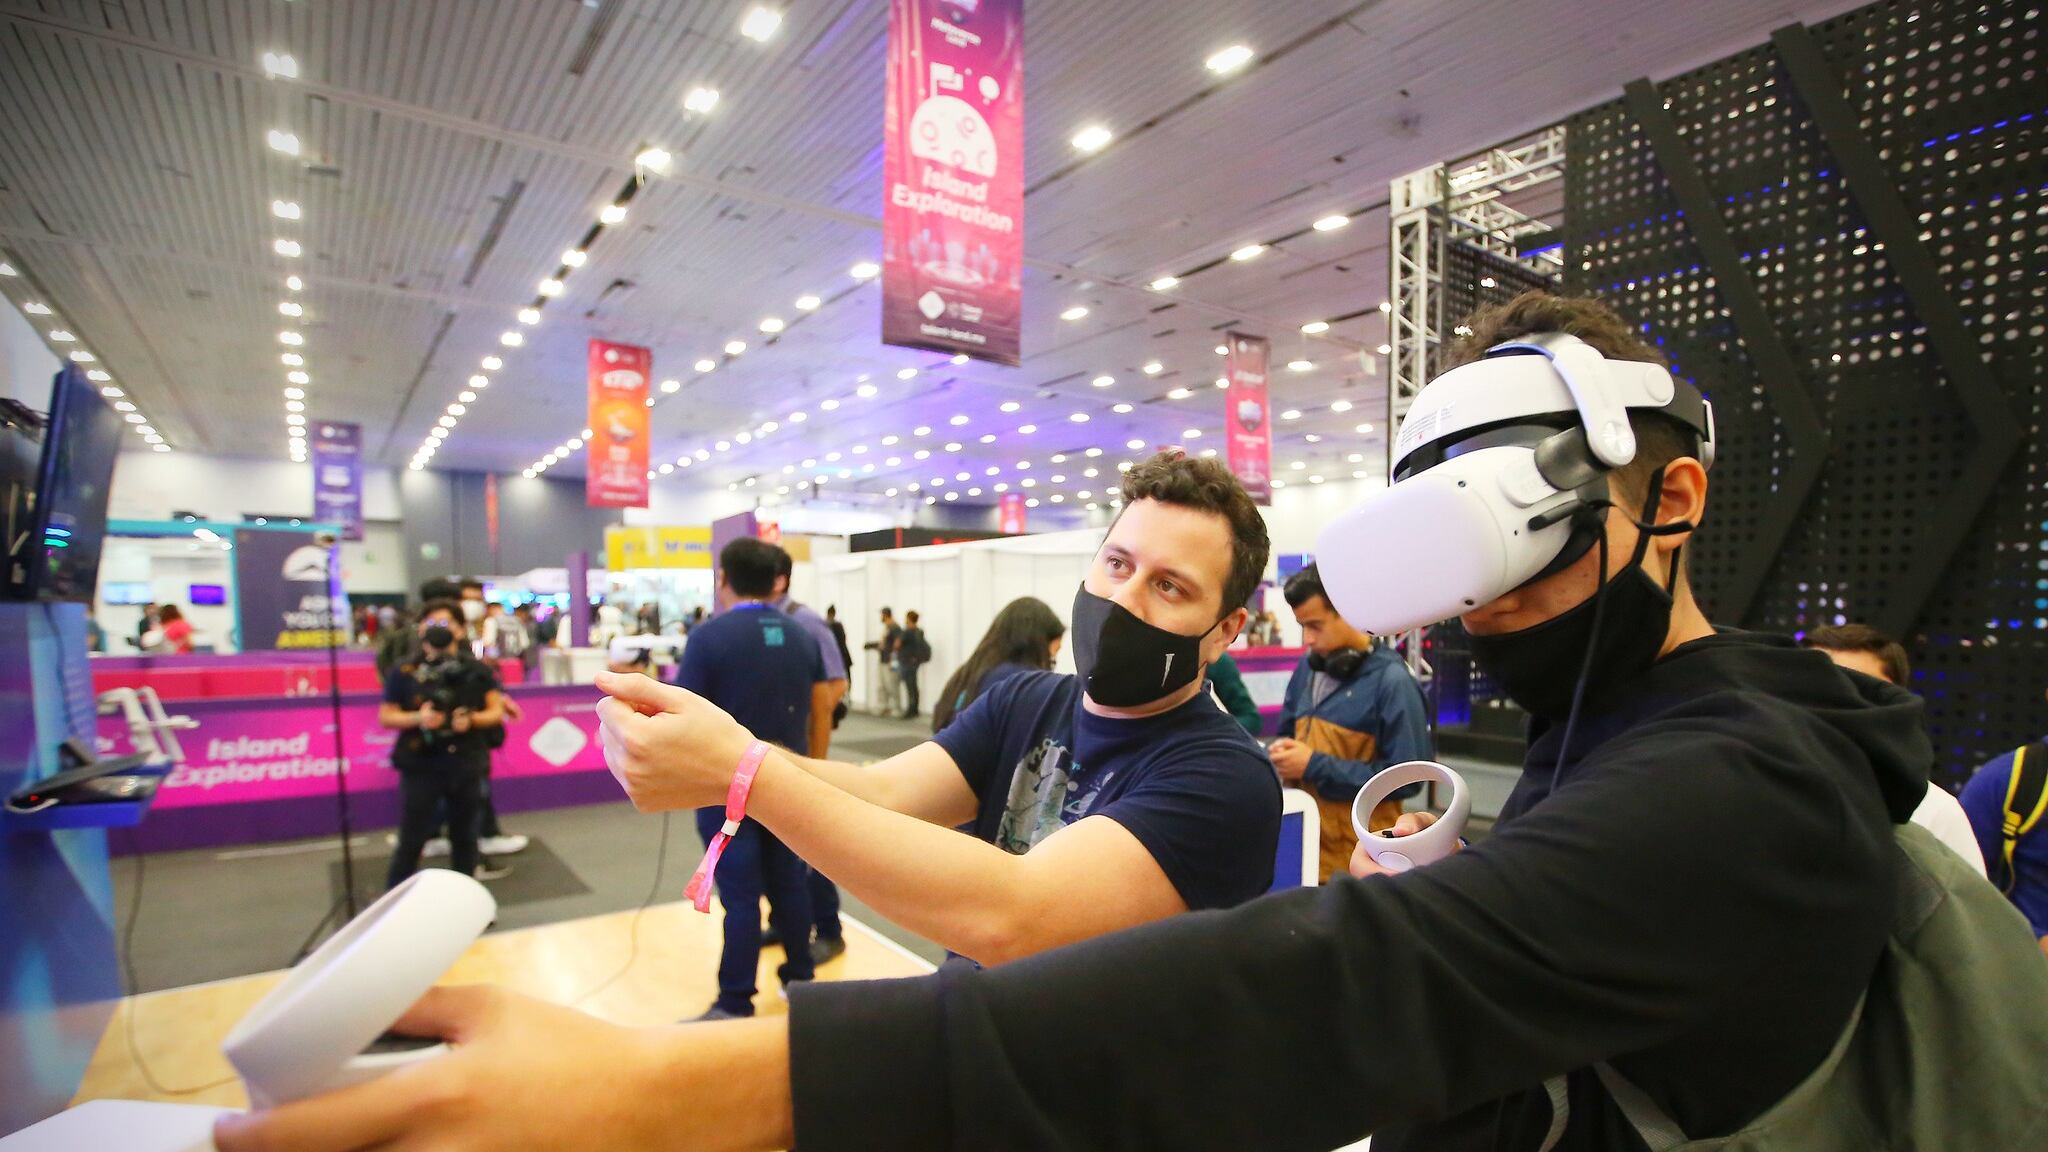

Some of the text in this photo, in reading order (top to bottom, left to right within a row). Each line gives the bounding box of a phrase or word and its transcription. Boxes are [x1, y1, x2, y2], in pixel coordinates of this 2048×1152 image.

[922, 165, 988, 203] Island
[892, 183, 1013, 232] Exploration
[207, 732, 310, 761] Island
[163, 754, 350, 789] Exploration
